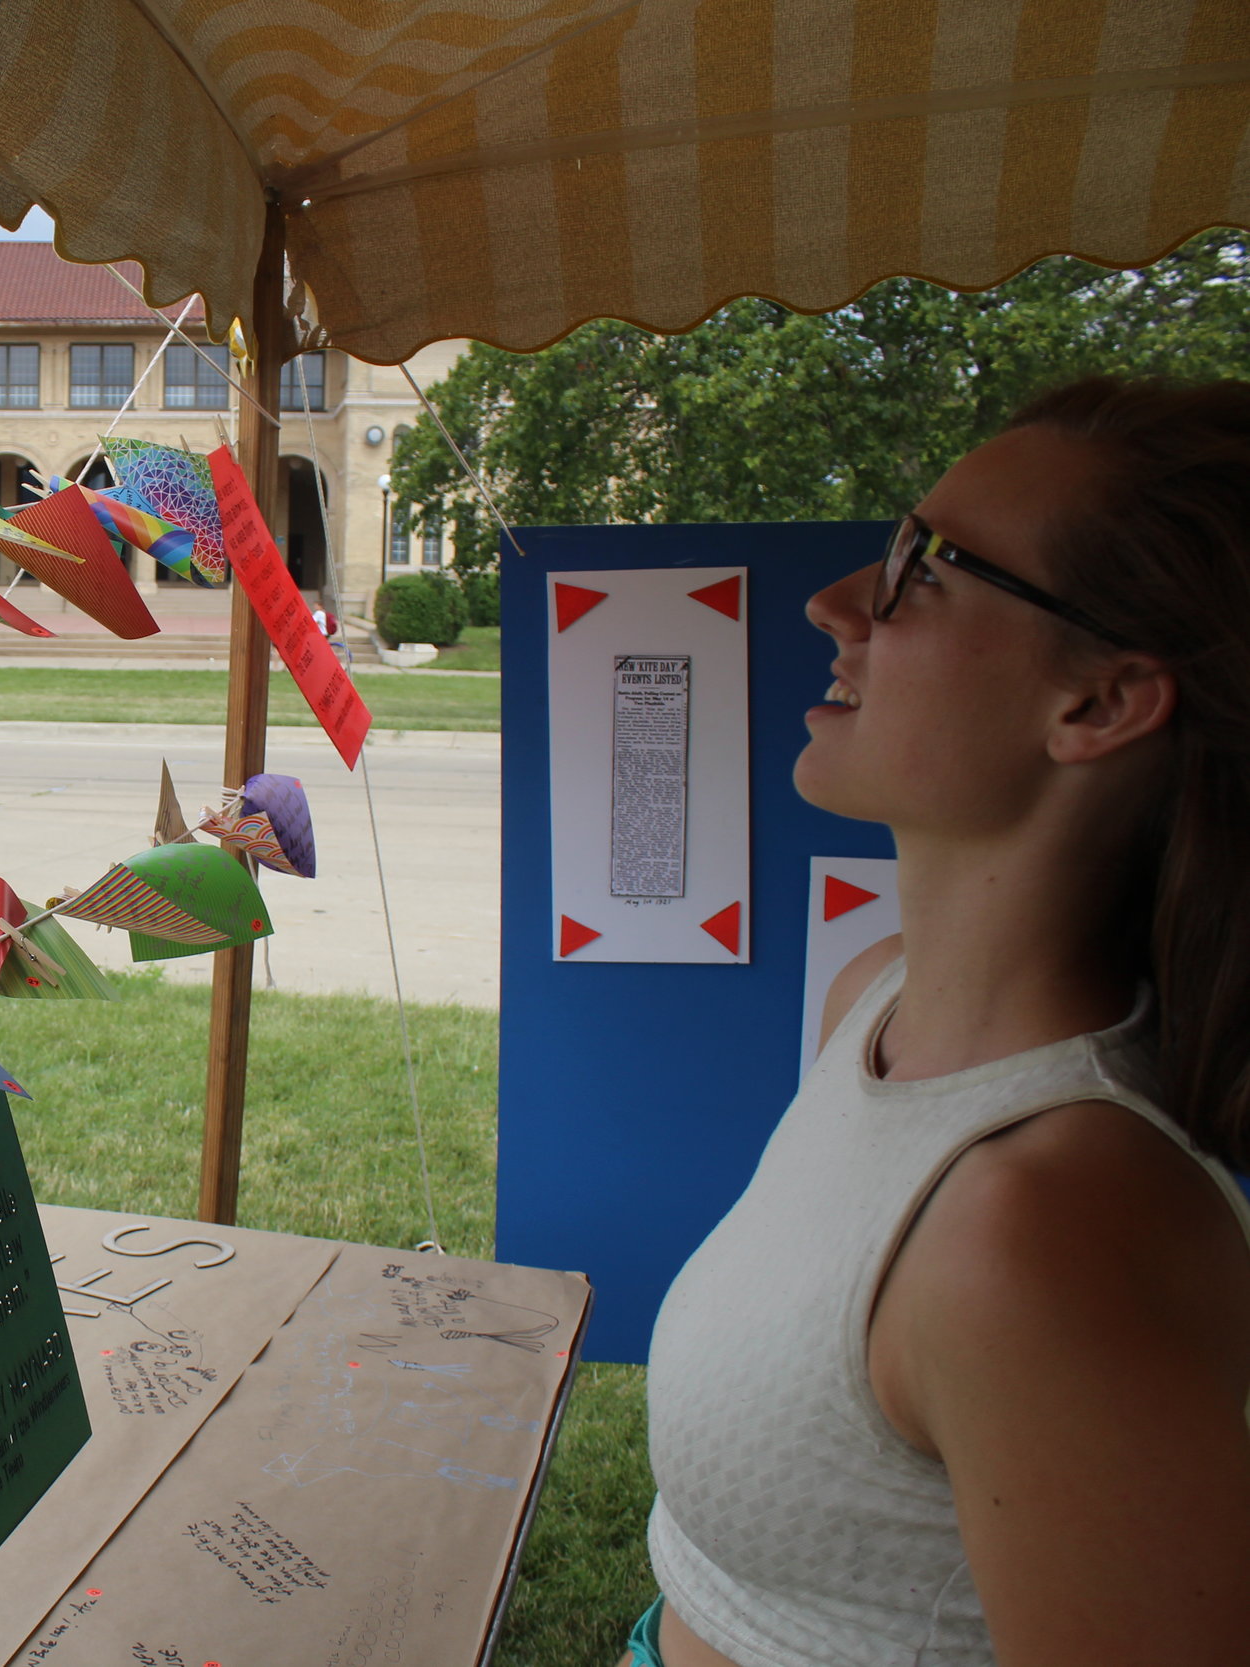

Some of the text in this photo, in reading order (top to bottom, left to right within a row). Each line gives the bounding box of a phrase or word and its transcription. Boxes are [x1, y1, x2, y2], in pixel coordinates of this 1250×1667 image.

[621, 673, 682, 685] EVENTS LISTED
[7, 1331, 64, 1405] MAYNARD
